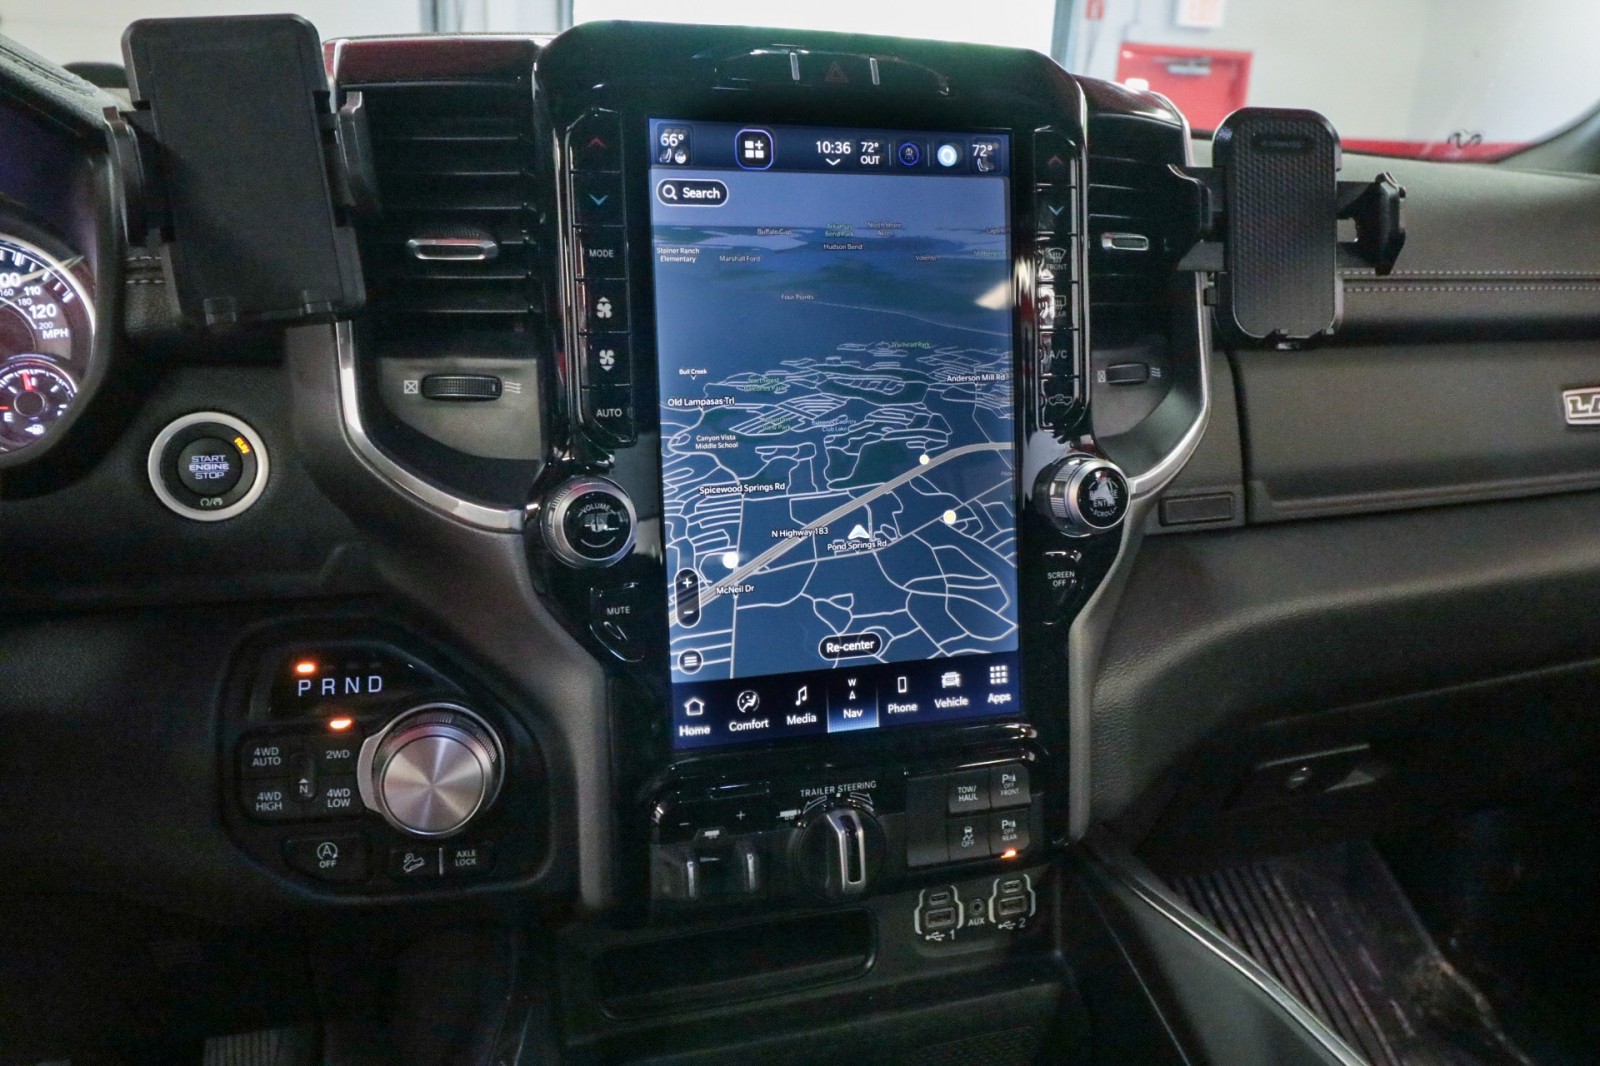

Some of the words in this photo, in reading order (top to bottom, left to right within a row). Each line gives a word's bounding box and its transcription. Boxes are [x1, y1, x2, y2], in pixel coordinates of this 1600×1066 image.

[816, 141, 851, 154] 10:36
[861, 142, 879, 153] 72°
[972, 144, 993, 157] 72°
[860, 155, 880, 165] OUT
[682, 187, 721, 199] Search
[589, 250, 614, 258] MODE
[660, 255, 697, 264] Elementary
[23, 286, 41, 296] 110
[18, 298, 32, 306] 180
[29, 303, 57, 319] 120
[39, 322, 53, 330] 200
[42, 328, 69, 339] MPH
[1049, 350, 1068, 359] A/C
[667, 398, 683, 406] Old
[684, 398, 723, 407] Lampasas
[724, 396, 735, 405] Trl
[4, 412, 13, 422] E
[596, 408, 622, 418] AUTO
[696, 435, 720, 443] Canyon
[717, 441, 739, 449] School
[191, 454, 226, 463] START
[188, 463, 230, 471] ENGINE
[195, 471, 225, 480] STOP
[699, 485, 743, 495] Spicewood
[744, 484, 775, 493] Springs
[776, 483, 786, 491] Rd
[582, 502, 611, 514] VOLUME
[779, 529, 813, 539] Highway
[814, 527, 829, 535] 183
[827, 543, 847, 551] Pond
[847, 542, 876, 551] Springs
[1047, 571, 1075, 579] SCREEN
[1052, 579, 1067, 587] OFF
[716, 586, 744, 594] McNeil
[745, 584, 755, 593] Dr
[606, 606, 631, 615] MUTE
[826, 641, 875, 653] Re-center
[298, 679, 311, 697] P
[321, 677, 335, 696] R
[345, 677, 360, 694] N
[368, 675, 383, 693] D
[847, 678, 857, 686] W
[934, 696, 969, 708] Vehicle
[988, 692, 1011, 705] Apps
[843, 708, 863, 718] Nav
[887, 703, 918, 714] Phone
[786, 713, 817, 725] Media
[679, 725, 711, 736] Home
[729, 719, 769, 732] Comfort
[253, 747, 279, 756] 4WD
[326, 750, 350, 759] 2WD
[252, 757, 281, 767] AUTO
[299, 785, 309, 794] N
[326, 788, 350, 797] 4WD
[800, 785, 835, 798] TRAILER
[837, 780, 877, 793] STEERING
[958, 785, 977, 794] TOW/
[1000, 787, 1019, 796] FRONT
[257, 791, 282, 801] 4WD
[958, 793, 978, 802] HAUL
[255, 802, 283, 812] HIGH
[327, 799, 351, 808] LOW
[1001, 833, 1017, 841] REAR
[961, 839, 975, 848] OFF
[456, 850, 476, 858] AXLE
[319, 859, 337, 869] OFF
[455, 858, 477, 867] LOCK
[967, 917, 985, 926] AUX
[1019, 917, 1026, 928] 2
[949, 929, 955, 940] 1
